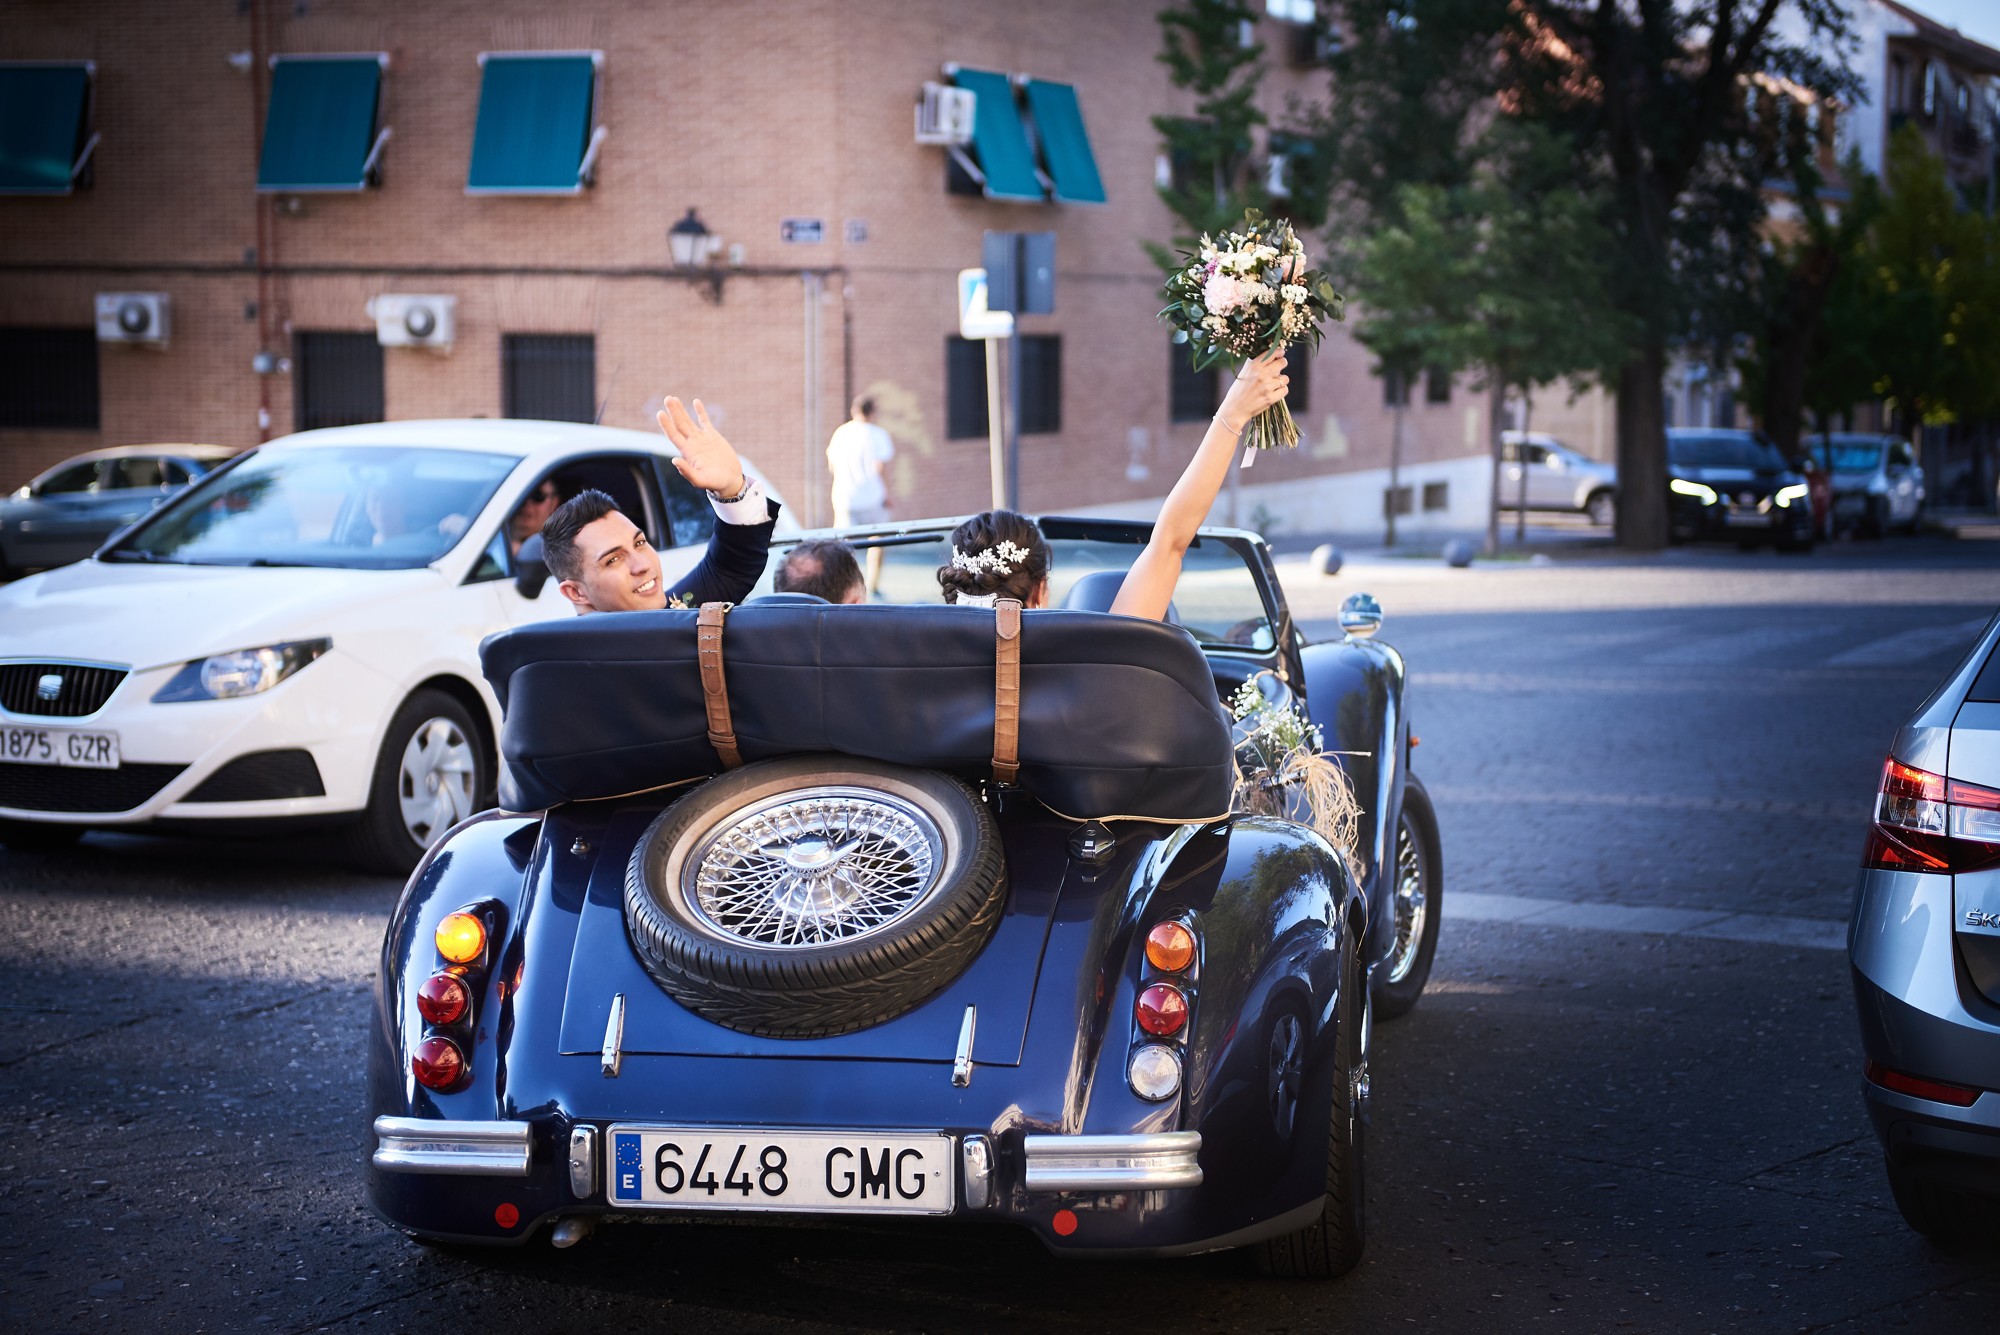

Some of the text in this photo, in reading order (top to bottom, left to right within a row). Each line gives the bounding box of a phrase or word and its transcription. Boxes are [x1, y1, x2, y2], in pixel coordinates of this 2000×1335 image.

[0, 729, 111, 763] 1875 GZR
[1966, 908, 2000, 928] ŠK
[622, 1143, 926, 1200] E 6448 GMG
